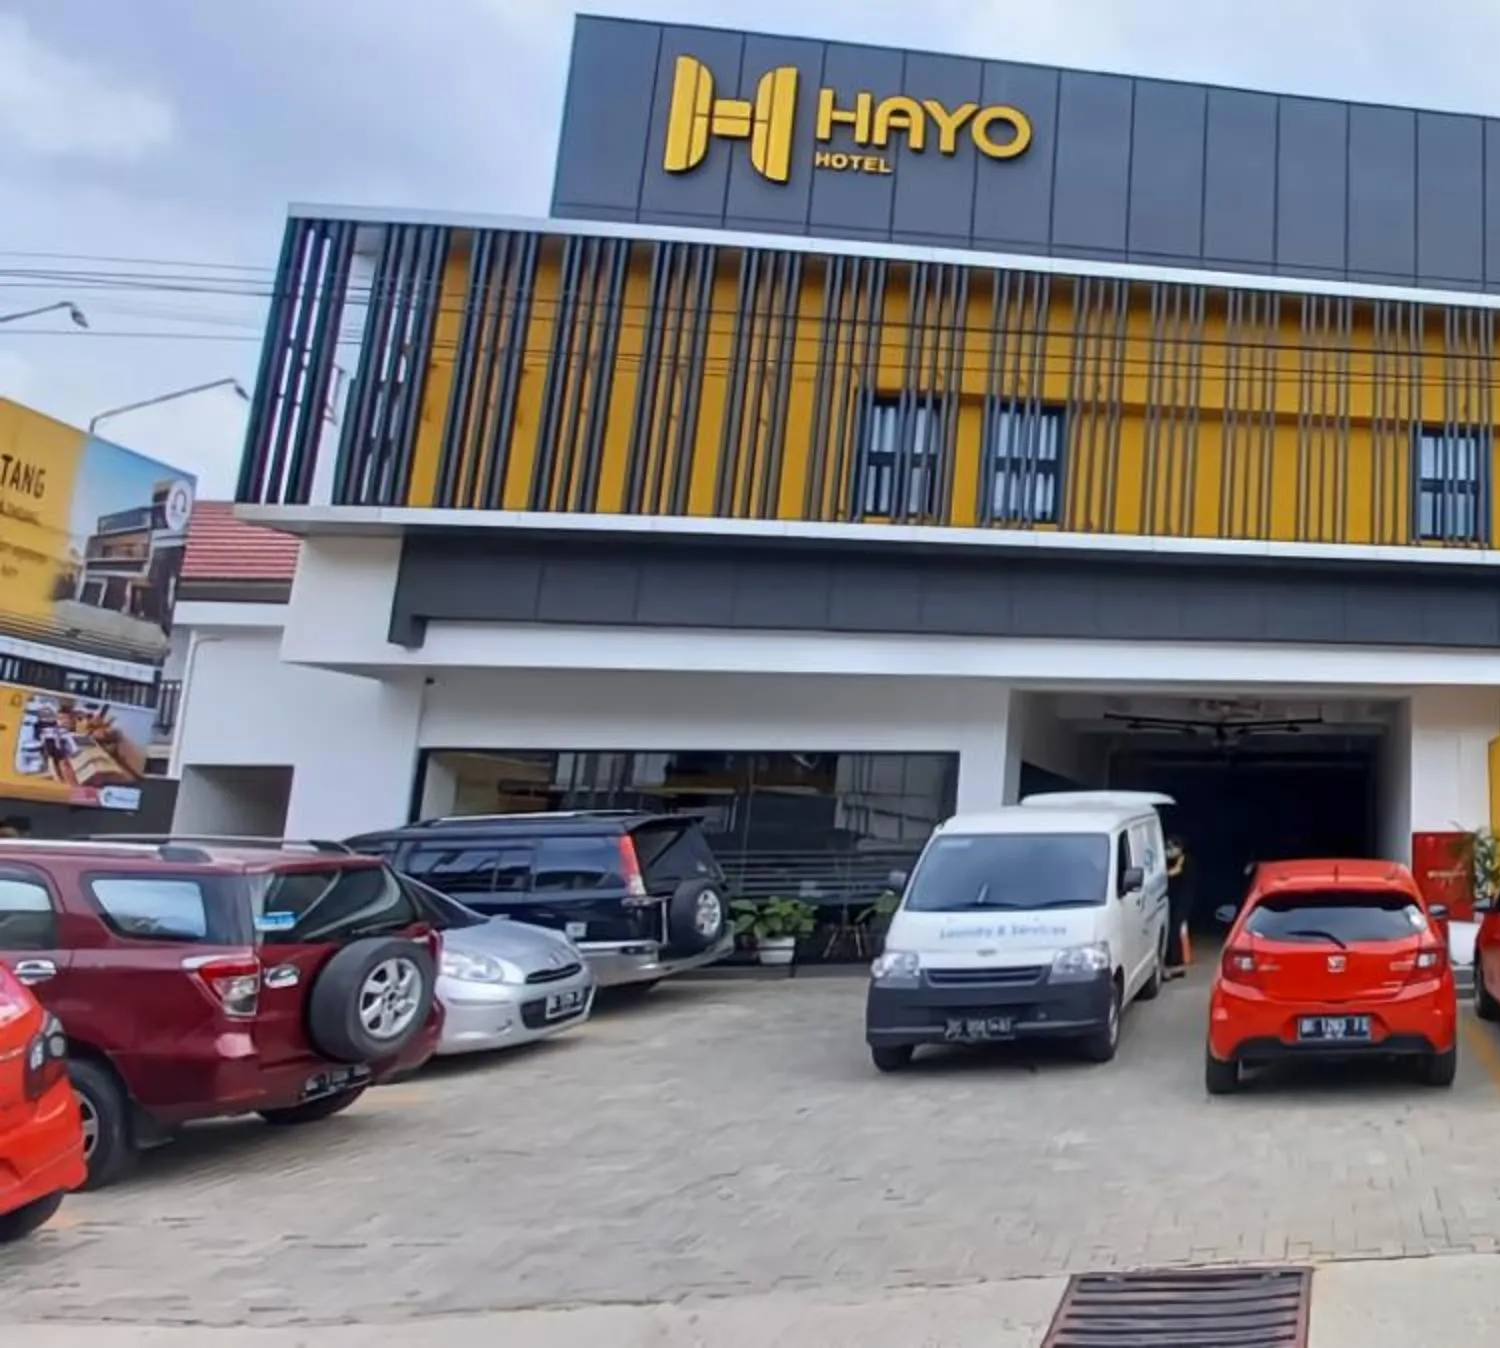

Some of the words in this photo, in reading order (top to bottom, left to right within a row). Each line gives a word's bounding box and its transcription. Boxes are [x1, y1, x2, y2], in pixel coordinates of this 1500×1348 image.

[815, 88, 1032, 159] HAYO
[815, 151, 893, 174] HOTEL
[0, 453, 47, 499] TANG
